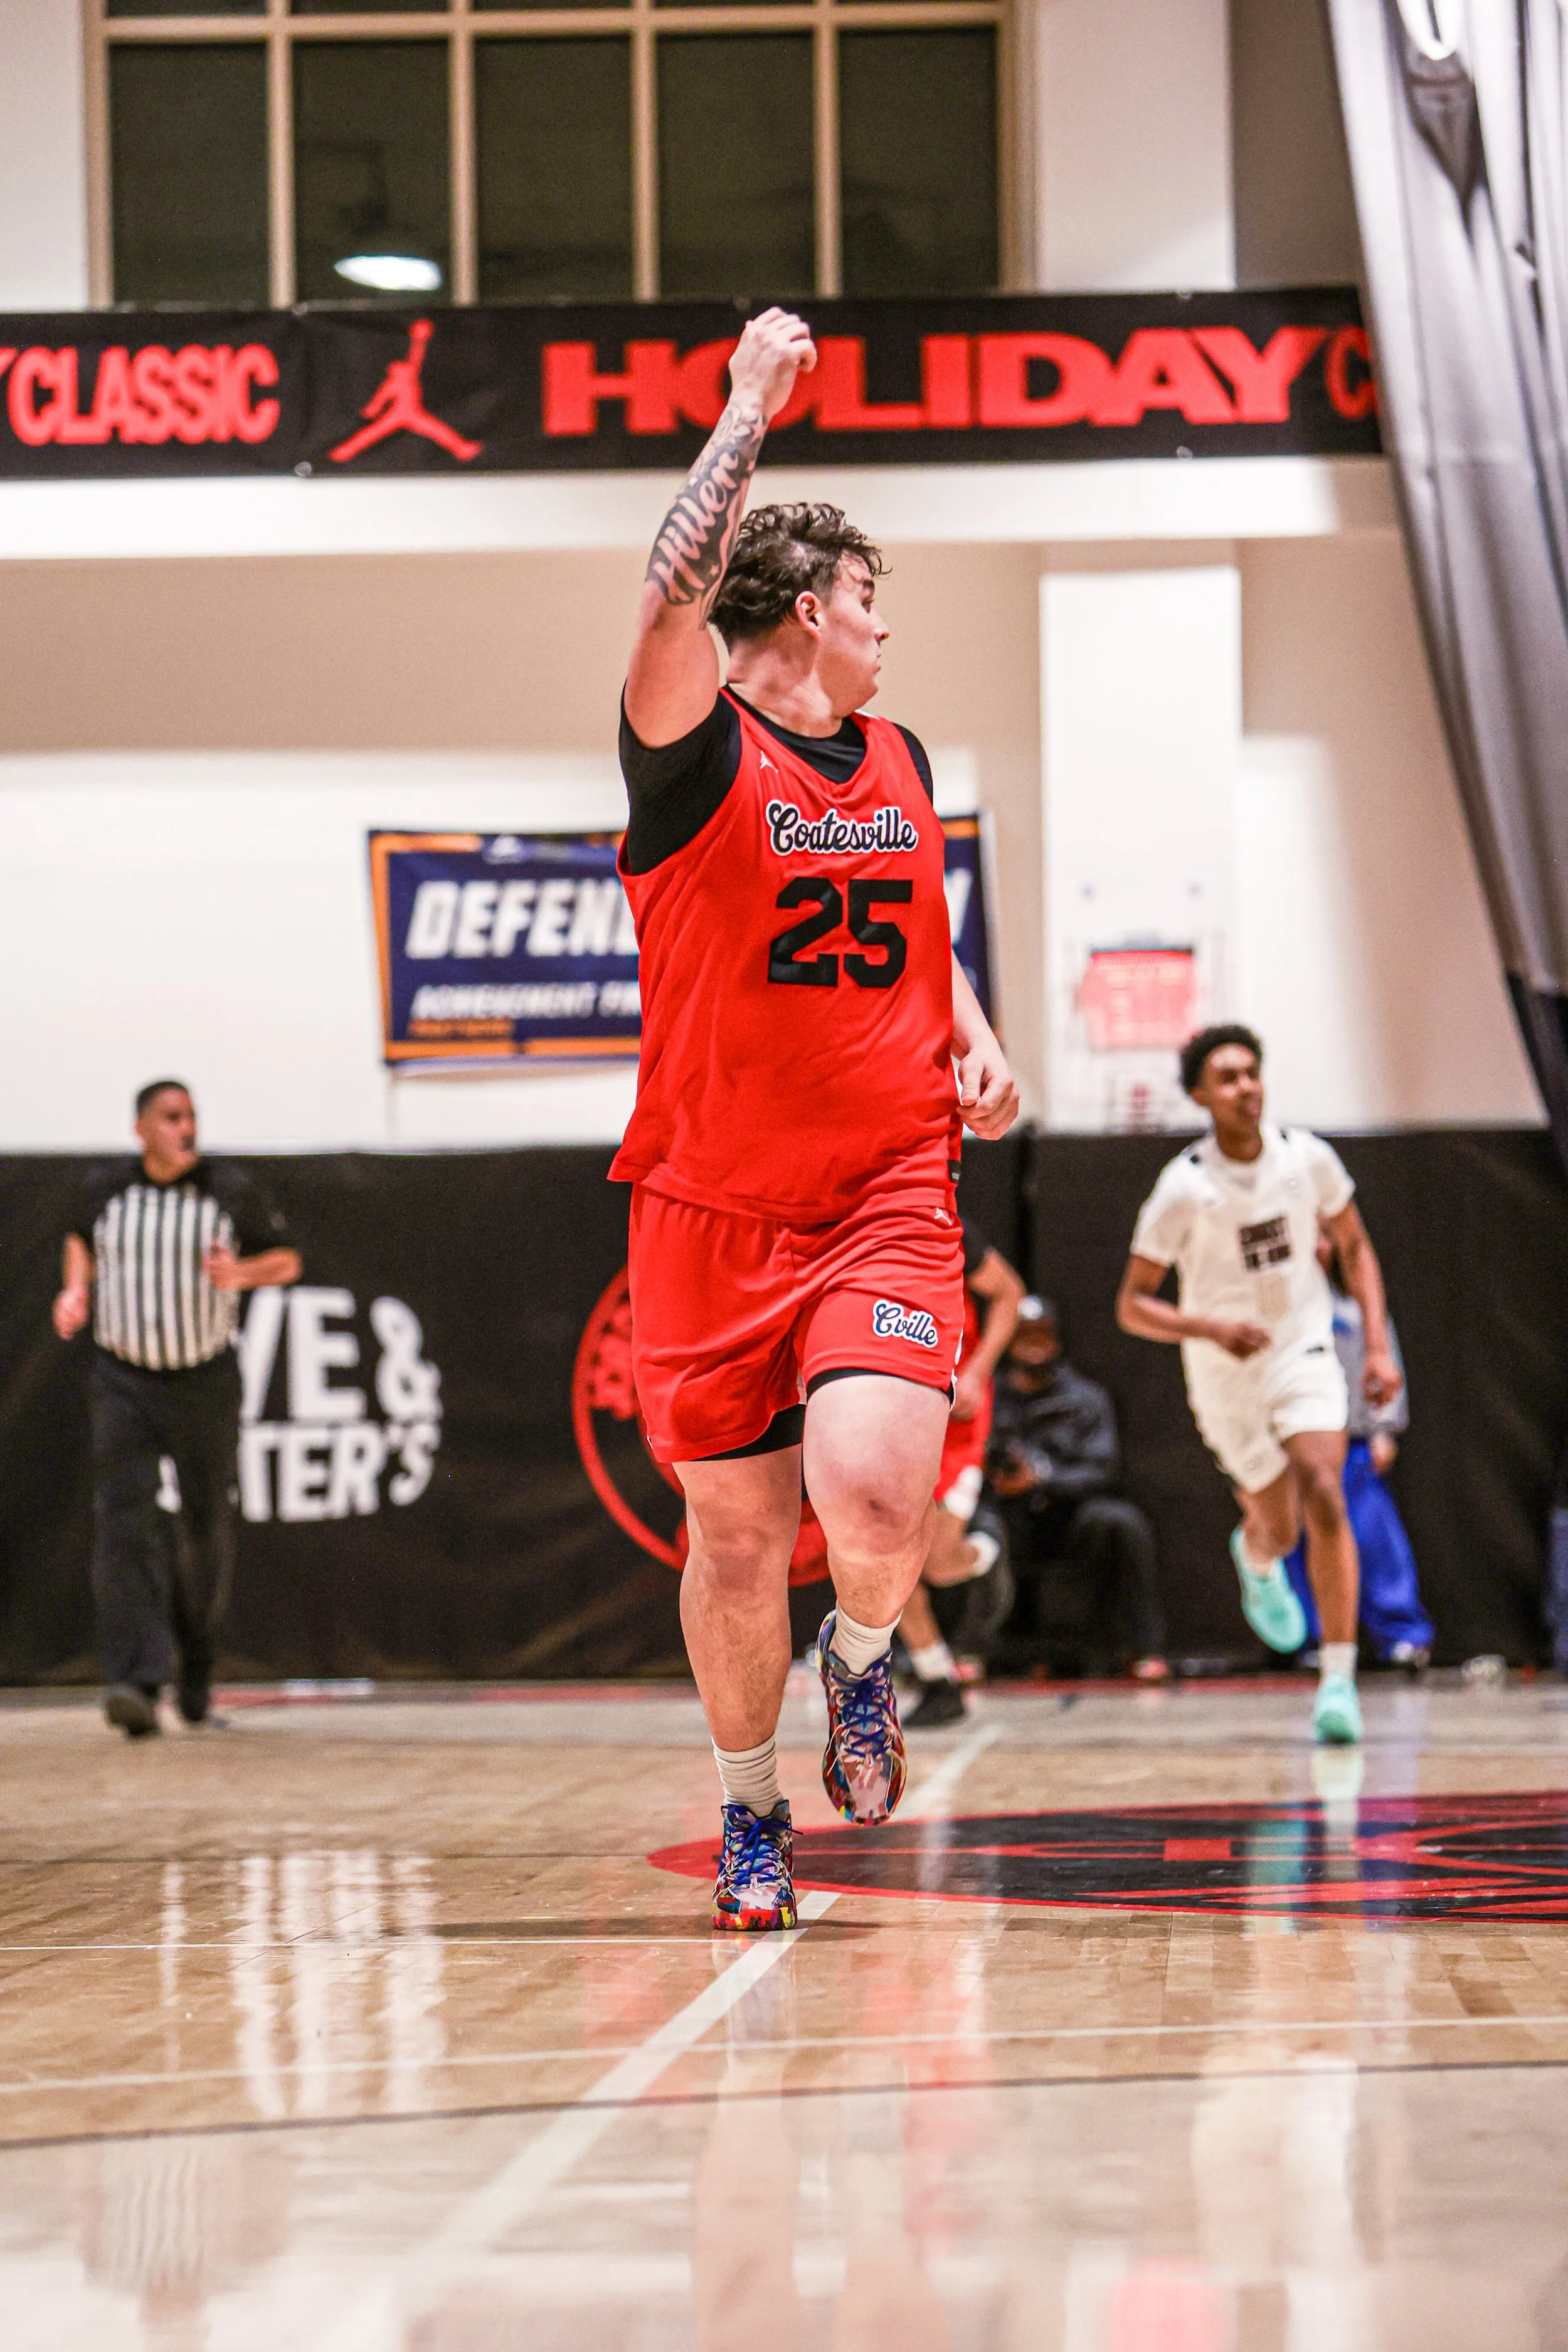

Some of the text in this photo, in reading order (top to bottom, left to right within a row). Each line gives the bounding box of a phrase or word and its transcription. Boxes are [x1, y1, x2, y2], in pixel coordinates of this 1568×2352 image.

[8, 344, 280, 445] CLASSIC
[767, 800, 918, 855] Coatesville
[768, 876, 913, 987] 25
[370, 1296, 442, 1422] &
[874, 1300, 938, 1348] Cville
[238, 1419, 441, 1523] TER'S
